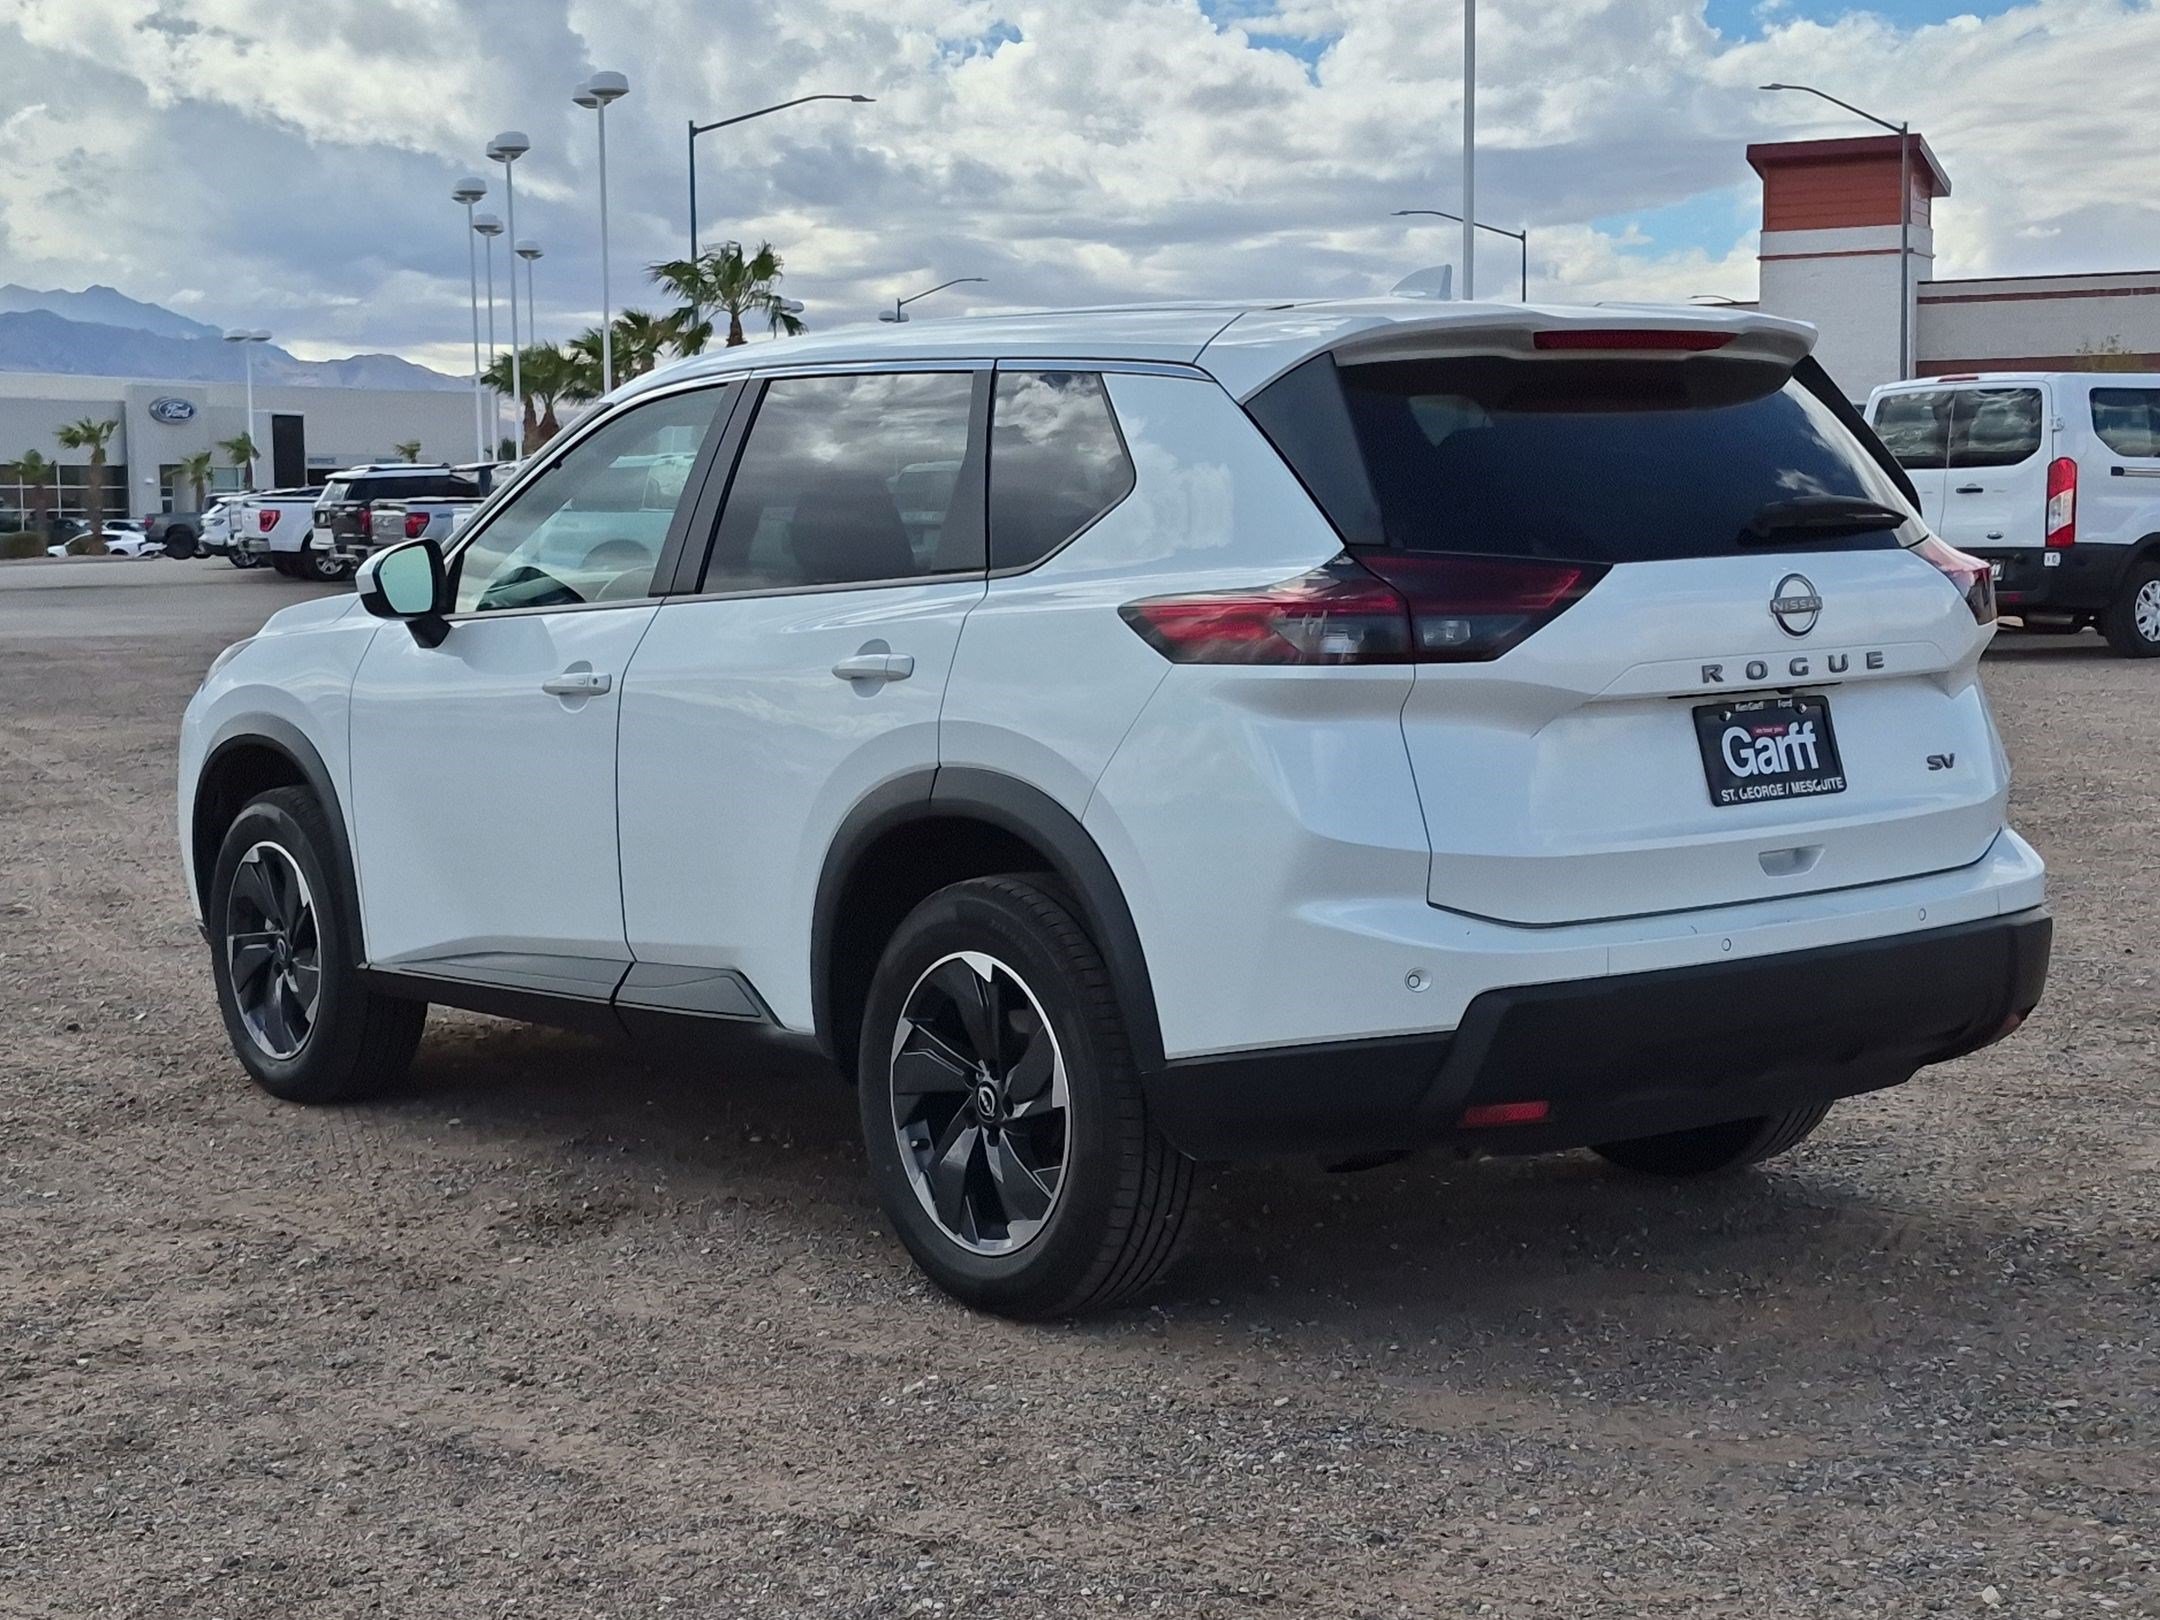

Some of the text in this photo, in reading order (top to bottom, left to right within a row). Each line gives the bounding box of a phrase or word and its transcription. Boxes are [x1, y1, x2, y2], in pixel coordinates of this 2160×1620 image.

[1772, 598, 1822, 612] NISSAN
[1701, 651, 1885, 684] ROGUE
[1721, 721, 1819, 777] Garff
[1927, 752, 1955, 771] SV
[1721, 789, 1739, 802] ST.
[1739, 783, 1785, 800] GEORGE
